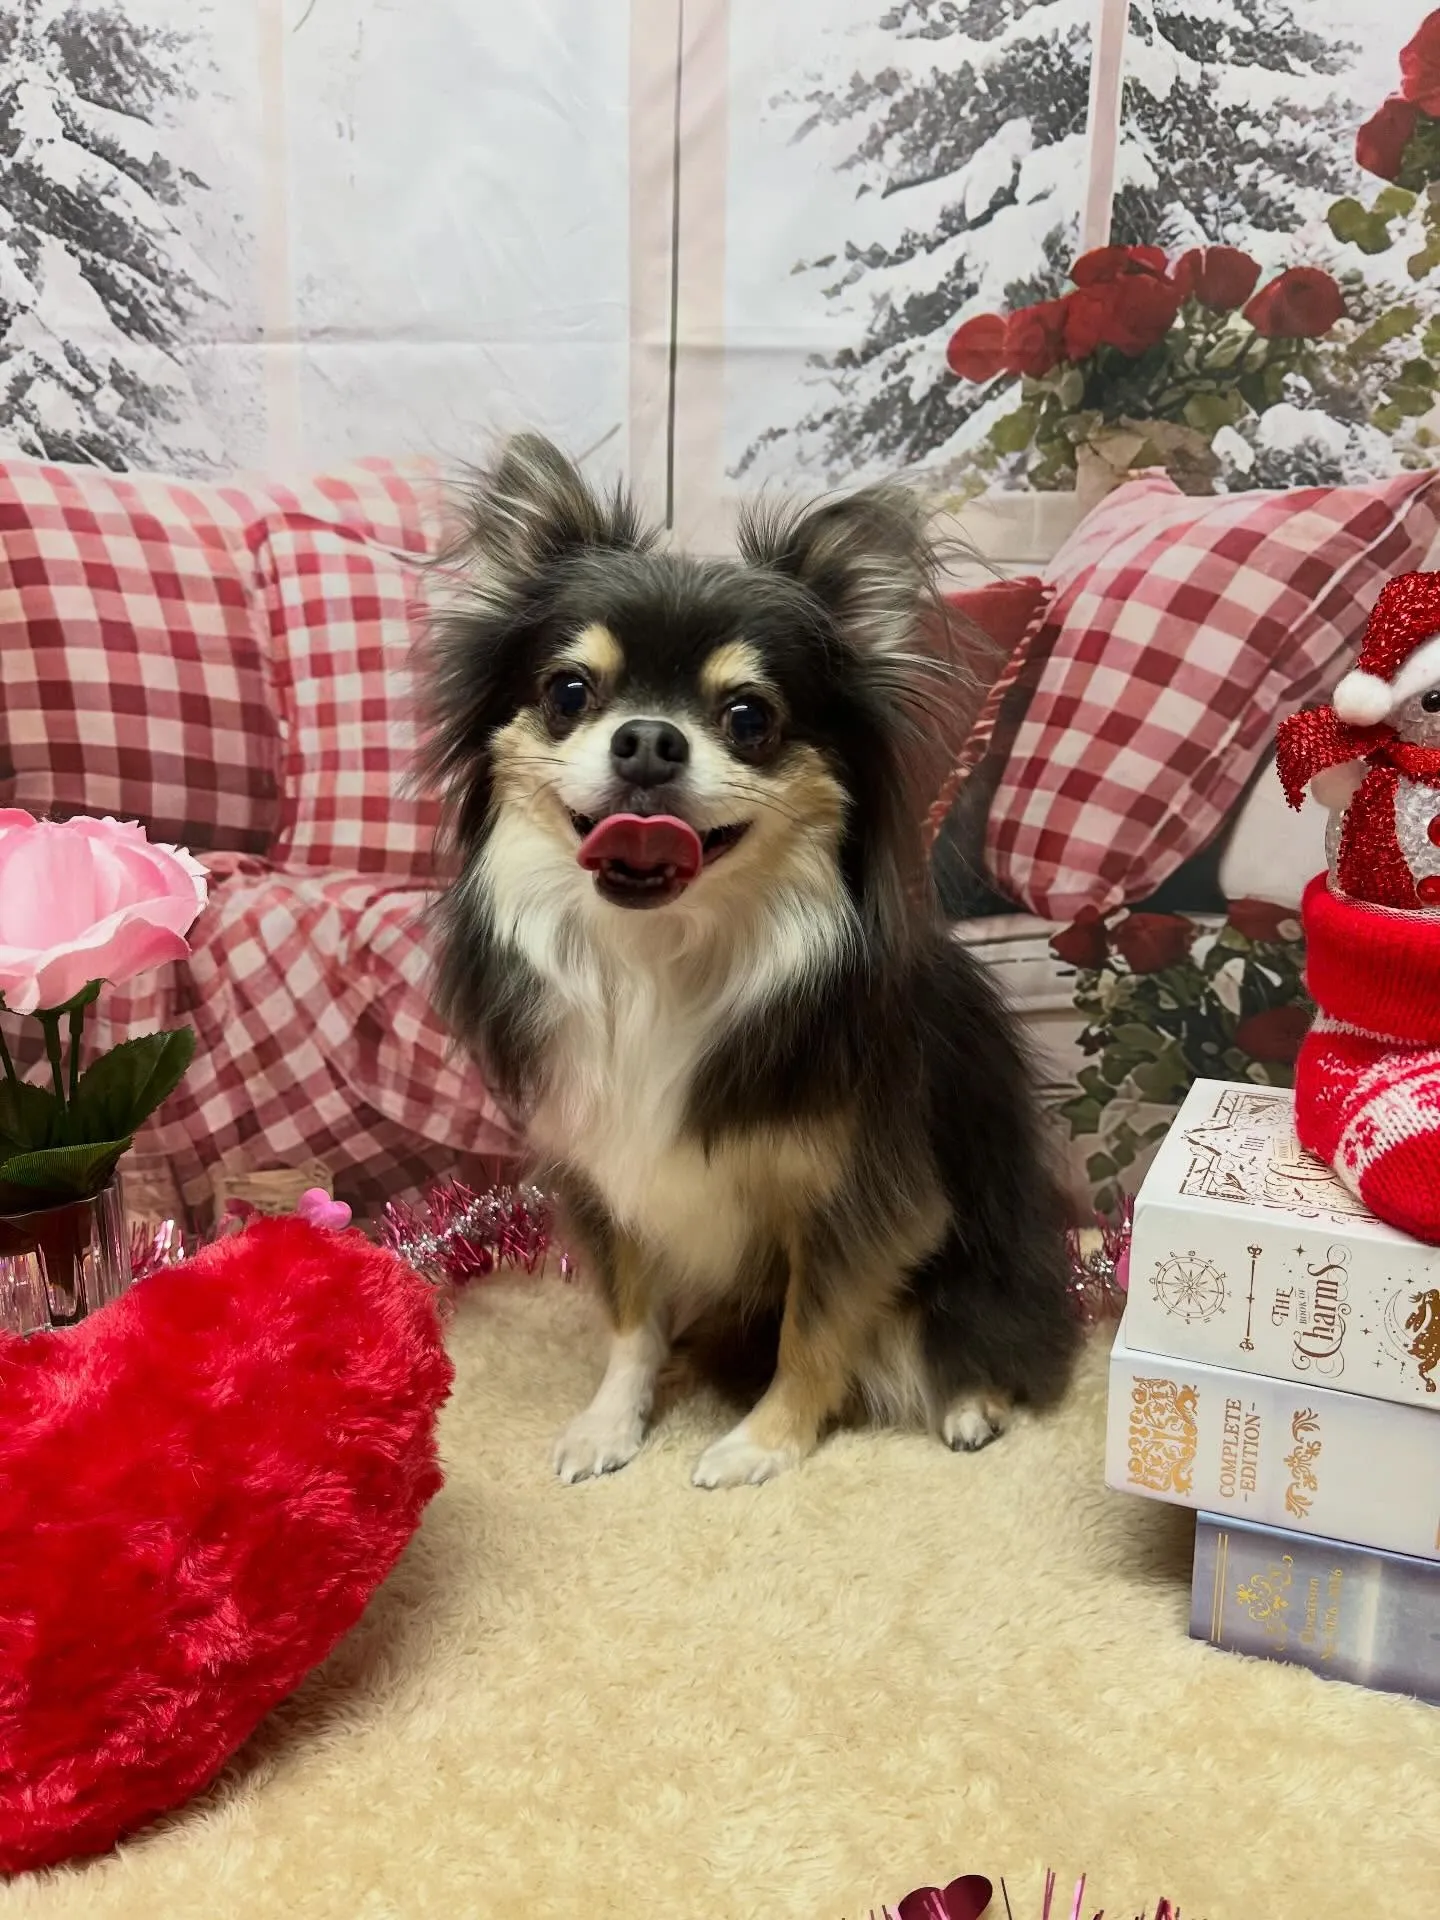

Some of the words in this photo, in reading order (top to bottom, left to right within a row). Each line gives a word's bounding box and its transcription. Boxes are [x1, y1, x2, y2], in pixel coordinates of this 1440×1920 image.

[1271, 1286, 1294, 1327] THE
[1298, 1301, 1309, 1325] BOOK
[1219, 1398, 1242, 1498] COMPLETE
